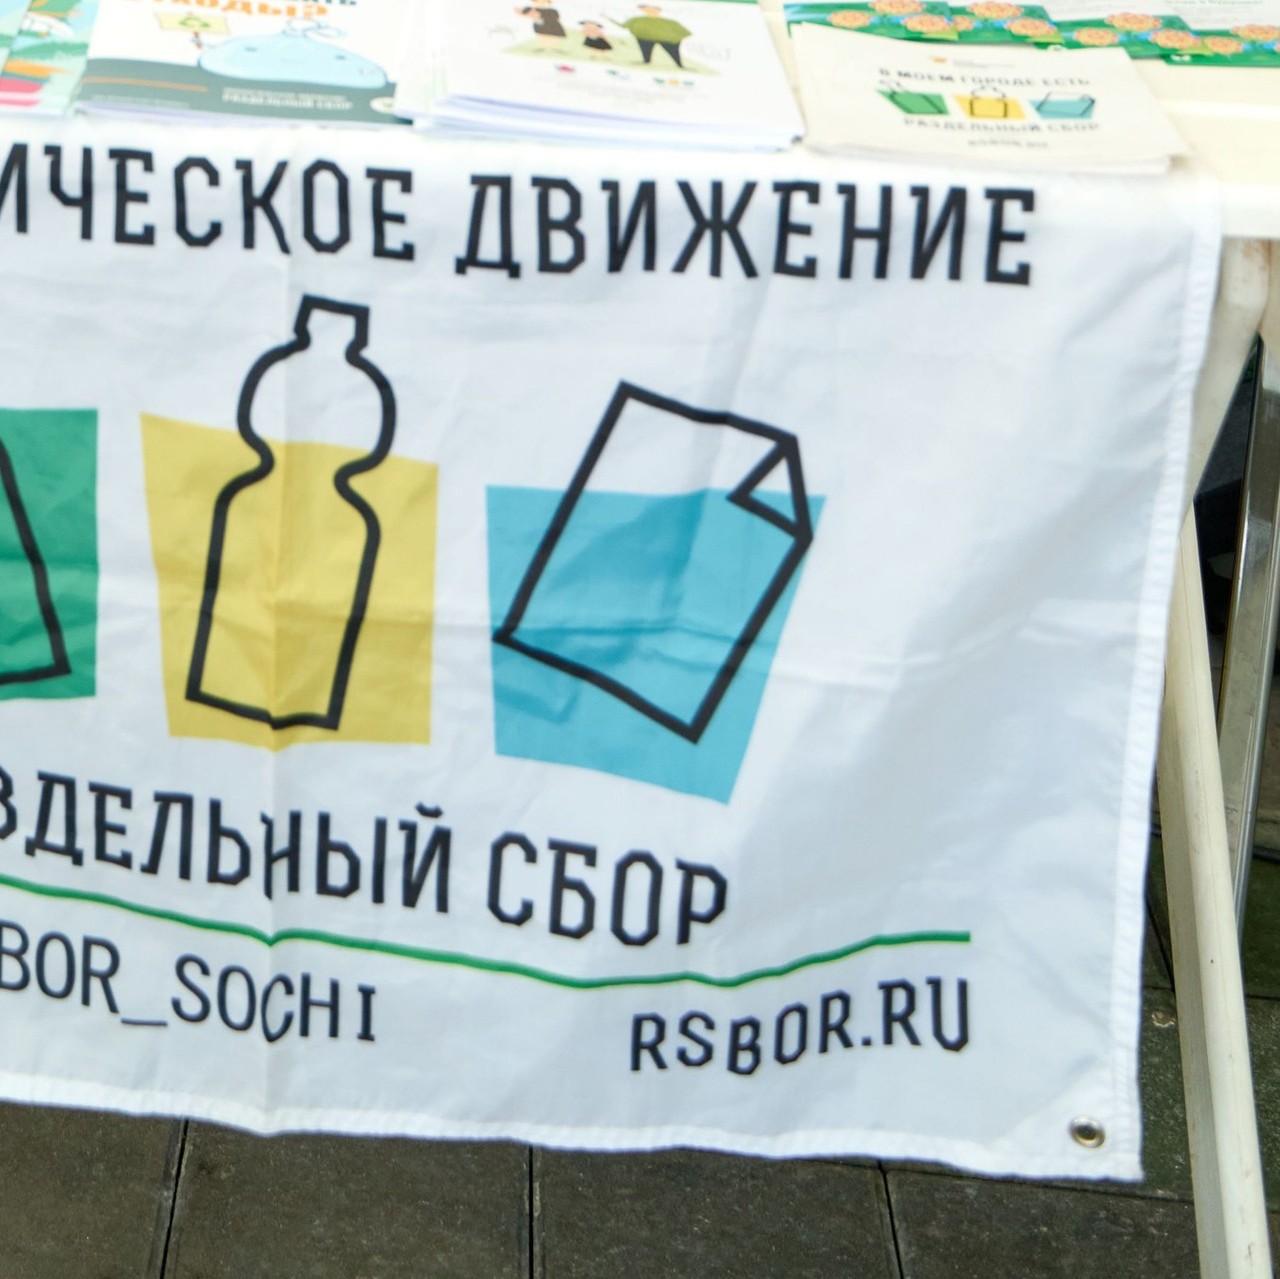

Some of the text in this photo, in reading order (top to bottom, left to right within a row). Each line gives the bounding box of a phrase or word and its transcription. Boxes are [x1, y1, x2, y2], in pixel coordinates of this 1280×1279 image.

[896, 70, 954, 83] МОЕМ
[454, 175, 1036, 287] ДВИЖЕНИЕ
[486, 831, 729, 948] СБОР
[630, 976, 970, 1077] RSBOR.RU
